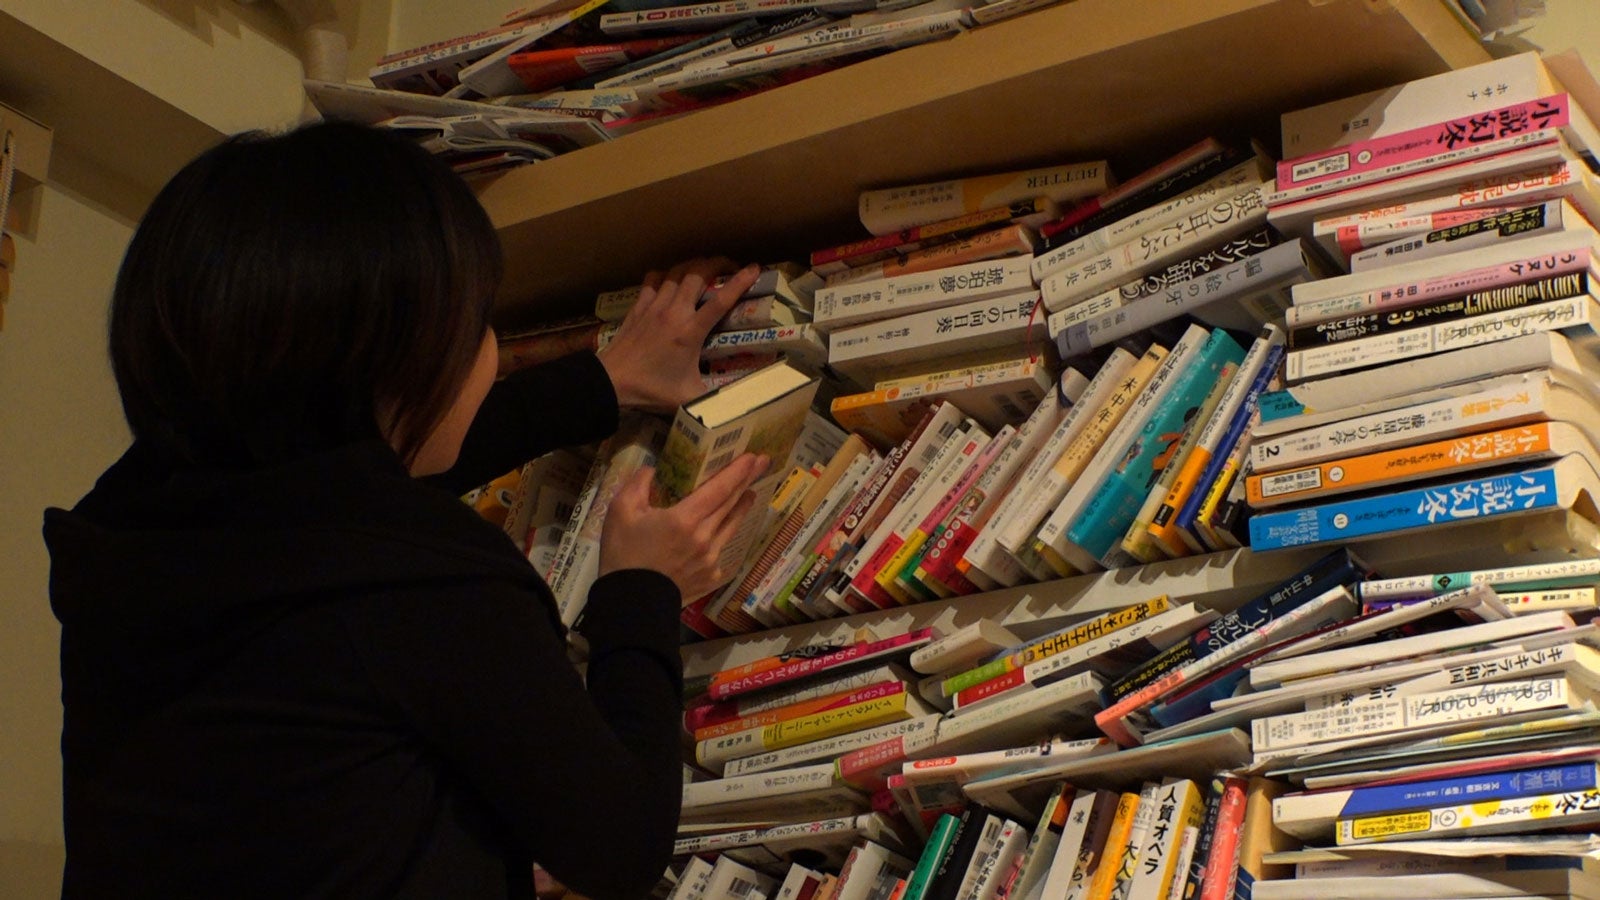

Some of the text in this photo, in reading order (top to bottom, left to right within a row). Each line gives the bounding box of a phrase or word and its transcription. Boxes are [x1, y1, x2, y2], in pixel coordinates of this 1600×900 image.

[1467, 82, 1508, 101] ホサナ
[1434, 99, 1562, 151] 小説幻冬
[1026, 167, 1096, 187] BUTTER
[1137, 187, 1265, 259] 獏の耳たぶ
[938, 266, 1006, 293] 琥珀の夢
[1063, 256, 1113, 287] 芦沢央
[1119, 229, 1273, 303] ワルツを踊ろう
[1509, 254, 1573, 276] うつヌケ
[1163, 258, 1263, 308] 騙し絵の牙
[1368, 285, 1417, 303] 田中圭一
[933, 299, 1037, 334] 盤上の向日葵
[1062, 296, 1113, 325] 中山七里
[1327, 414, 1426, 446] 藤沢周平の美学
[1446, 428, 1538, 463] 小説幻冬
[1265, 446, 1279, 457] 2
[1414, 473, 1546, 524] 小説幻冬
[1084, 622, 1160, 657] くちなし
[1206, 604, 1273, 651] ハーメルンの
[1449, 646, 1562, 684] キラキラ共和国
[1368, 683, 1396, 700] 小川
[1140, 784, 1181, 877] 人質オペラ
[1110, 840, 1139, 900] 大人ス
